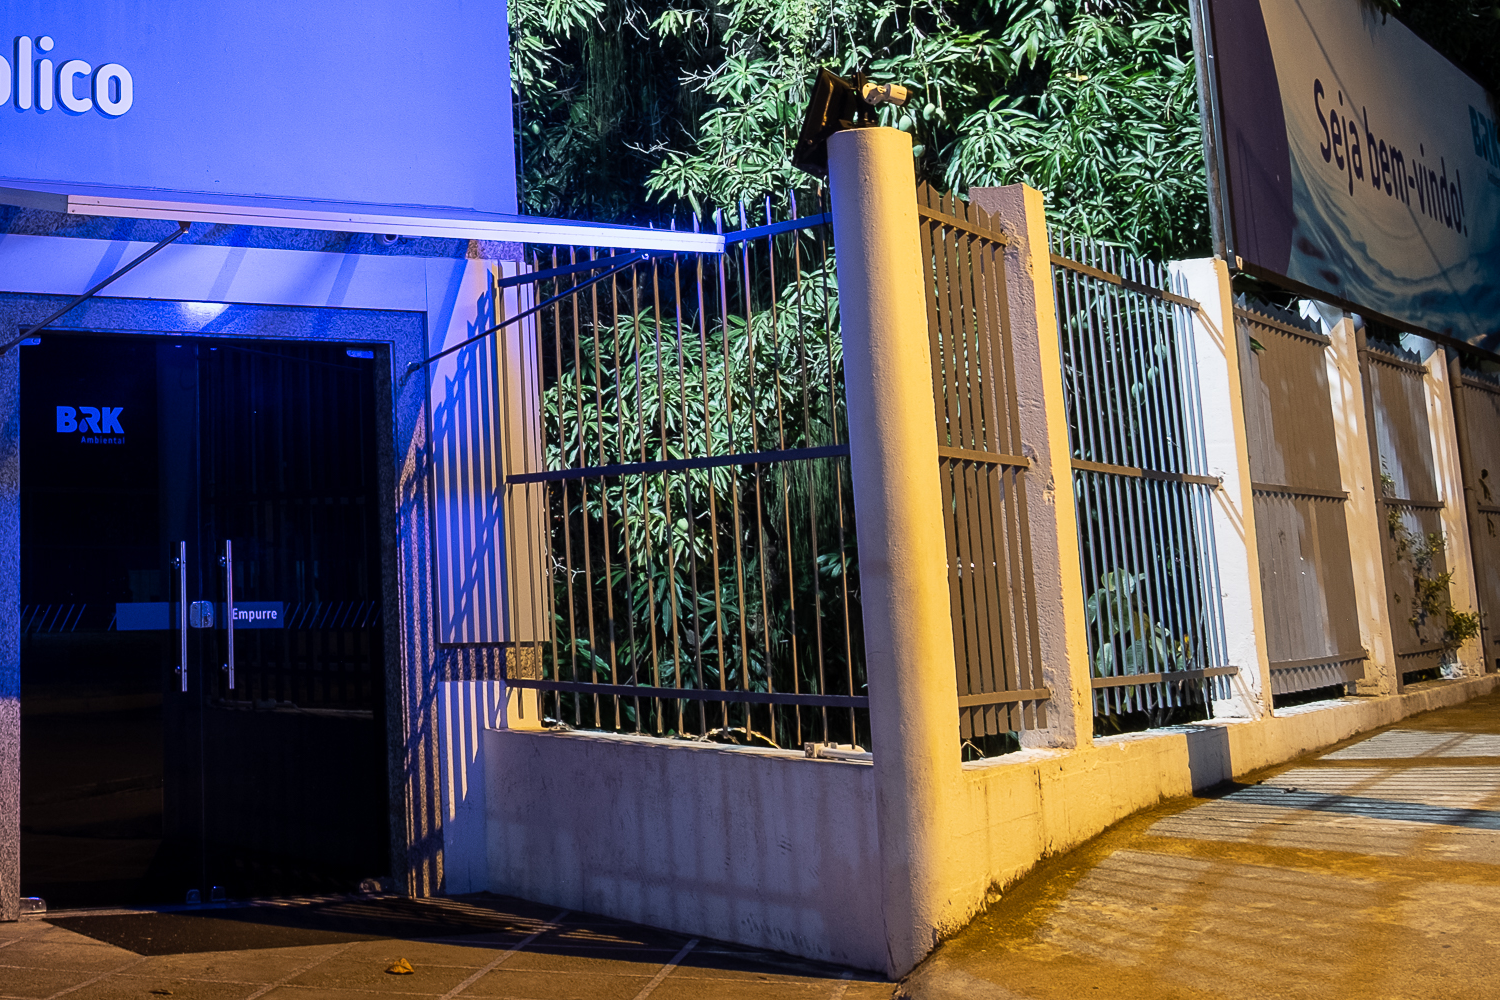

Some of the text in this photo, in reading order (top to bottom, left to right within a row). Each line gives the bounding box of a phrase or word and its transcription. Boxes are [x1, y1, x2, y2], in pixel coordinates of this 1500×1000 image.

[1313, 78, 1468, 238] Seja bem-vindo!
[56, 405, 125, 434] BRK
[80, 435, 126, 445] Ambiental
[232, 607, 278, 623] Empurre
